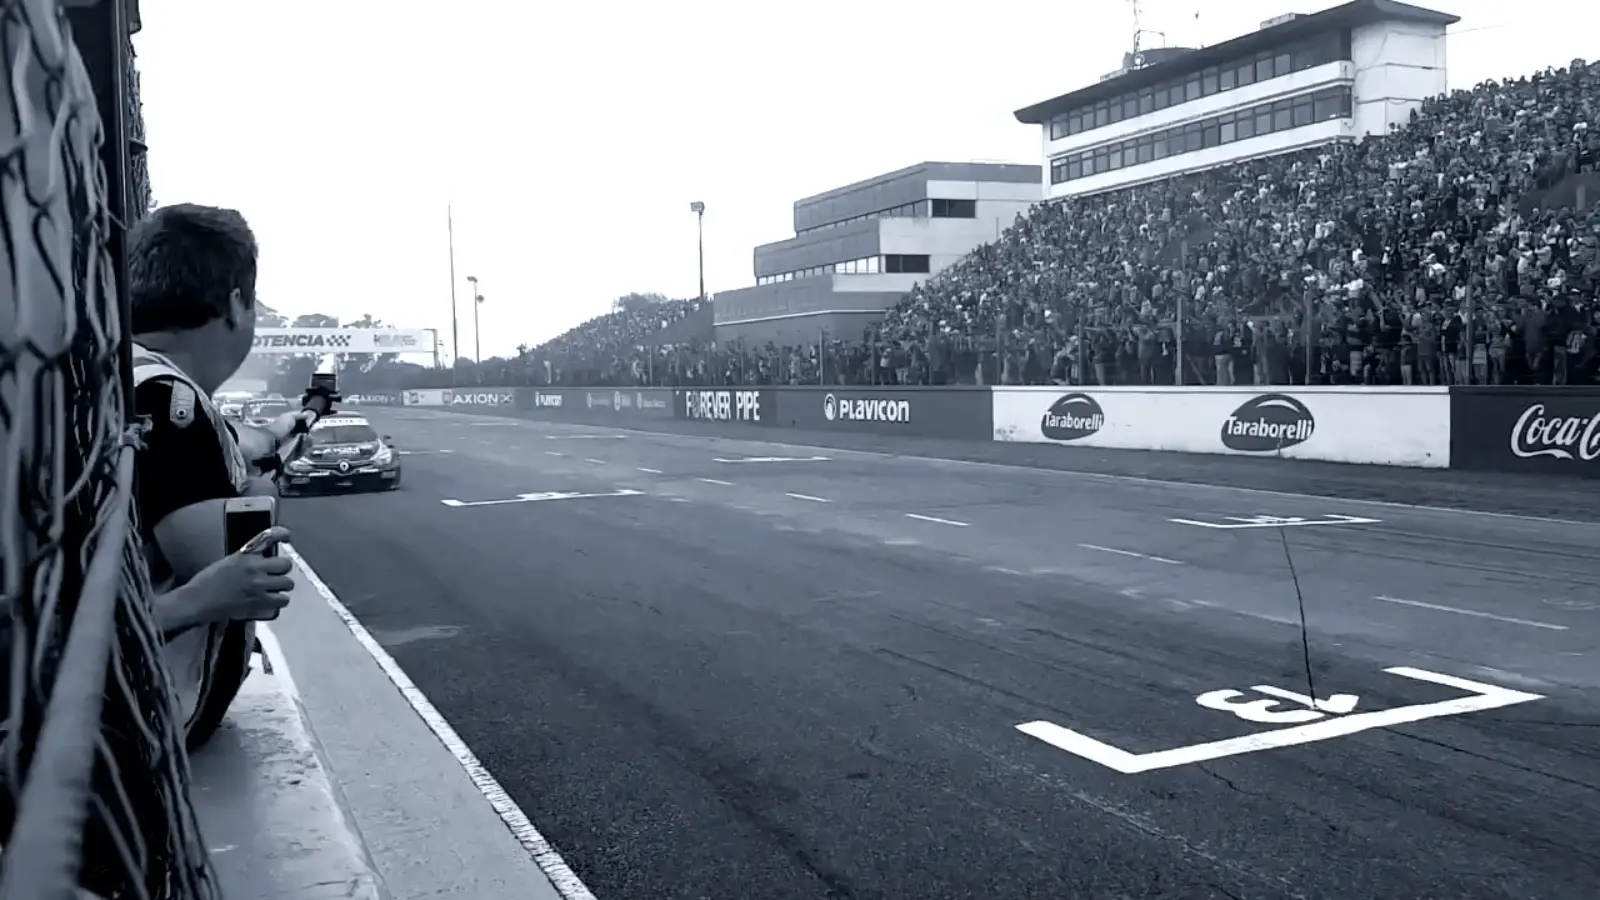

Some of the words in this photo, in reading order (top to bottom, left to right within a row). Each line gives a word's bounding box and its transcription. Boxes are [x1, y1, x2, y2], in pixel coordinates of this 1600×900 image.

[251, 334, 325, 347] OTENCIA
[453, 393, 499, 406] AXION
[685, 390, 732, 421] FOREVER
[735, 390, 760, 421] PIPE
[1044, 410, 1104, 431] Taraborelli
[1227, 415, 1313, 441] Taraborelli
